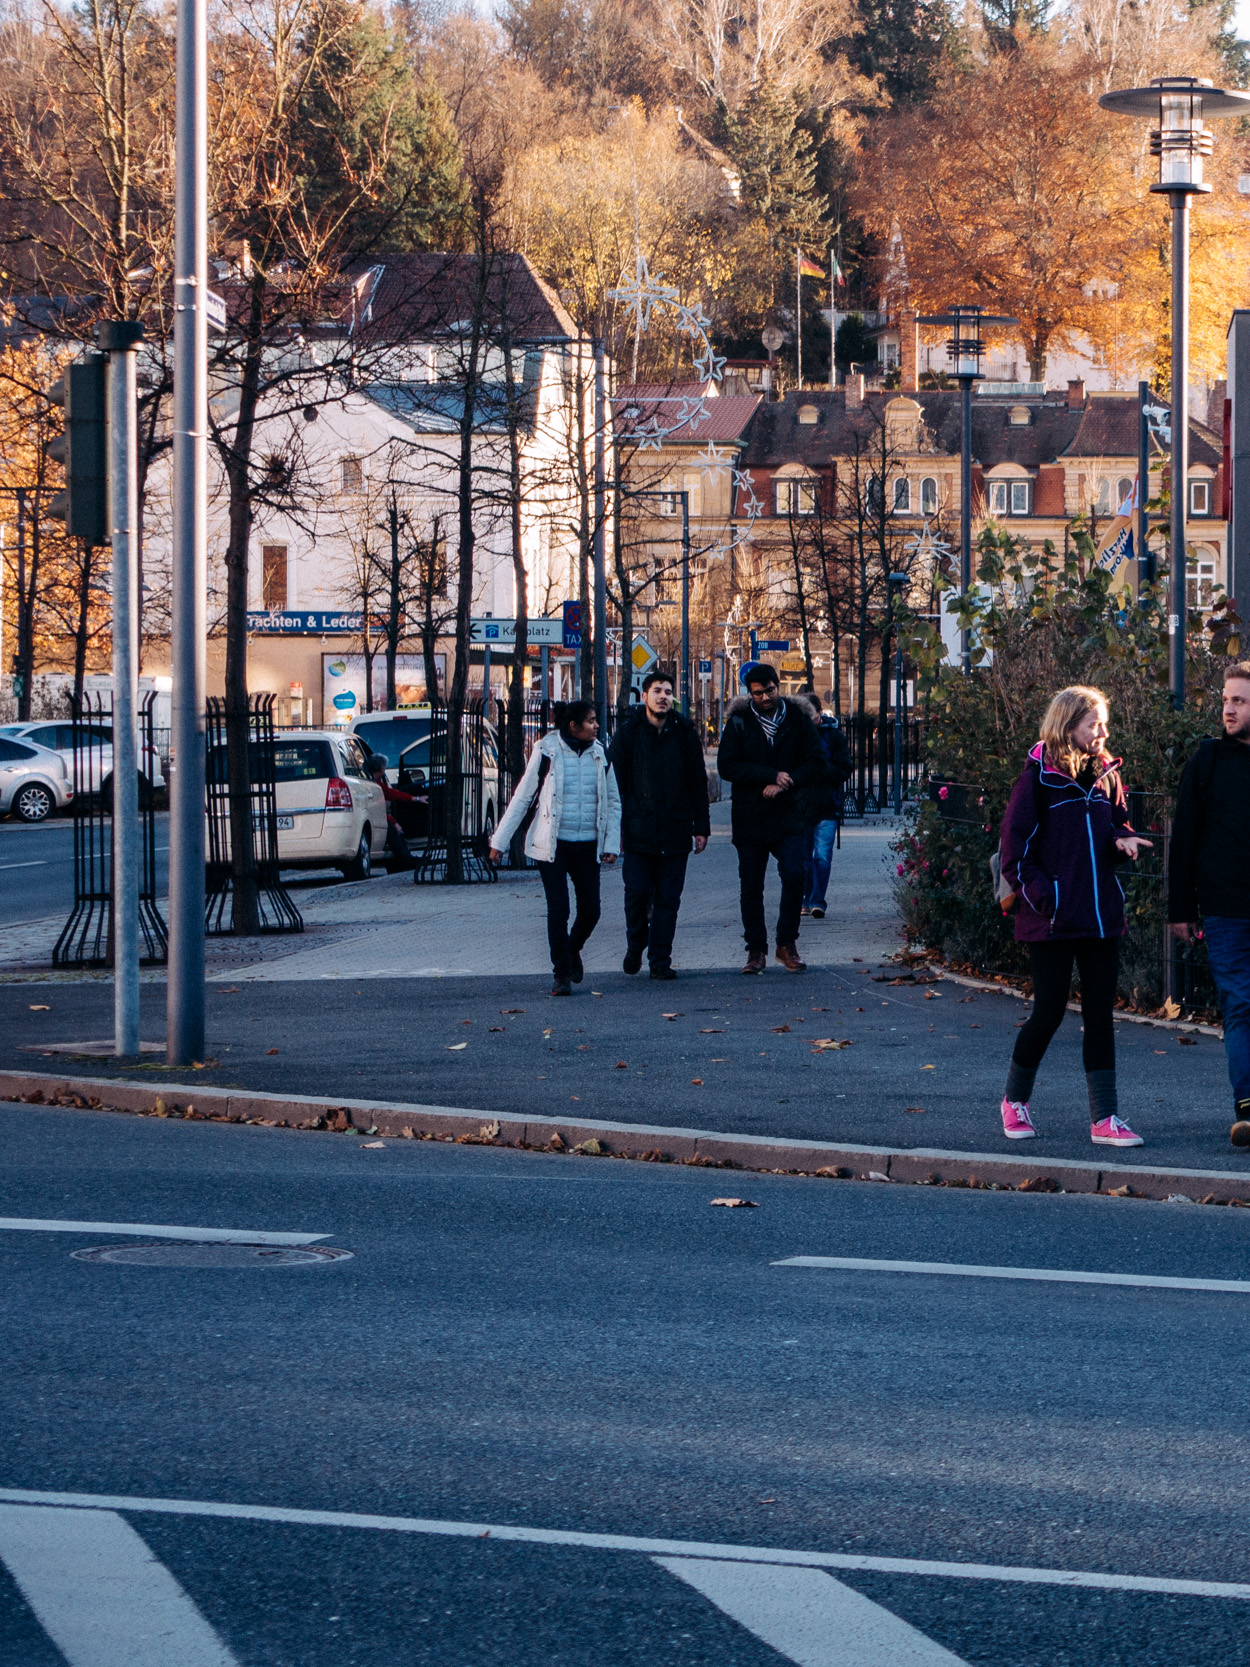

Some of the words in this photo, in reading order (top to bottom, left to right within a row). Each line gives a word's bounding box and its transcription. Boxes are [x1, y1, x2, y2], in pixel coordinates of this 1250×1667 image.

[248, 615, 301, 628] rachten
[306, 615, 317, 628] &
[322, 615, 362, 628] Leder
[502, 627, 550, 636] Kaplatz
[565, 634, 581, 645] TAX
[757, 641, 769, 649] ZOB
